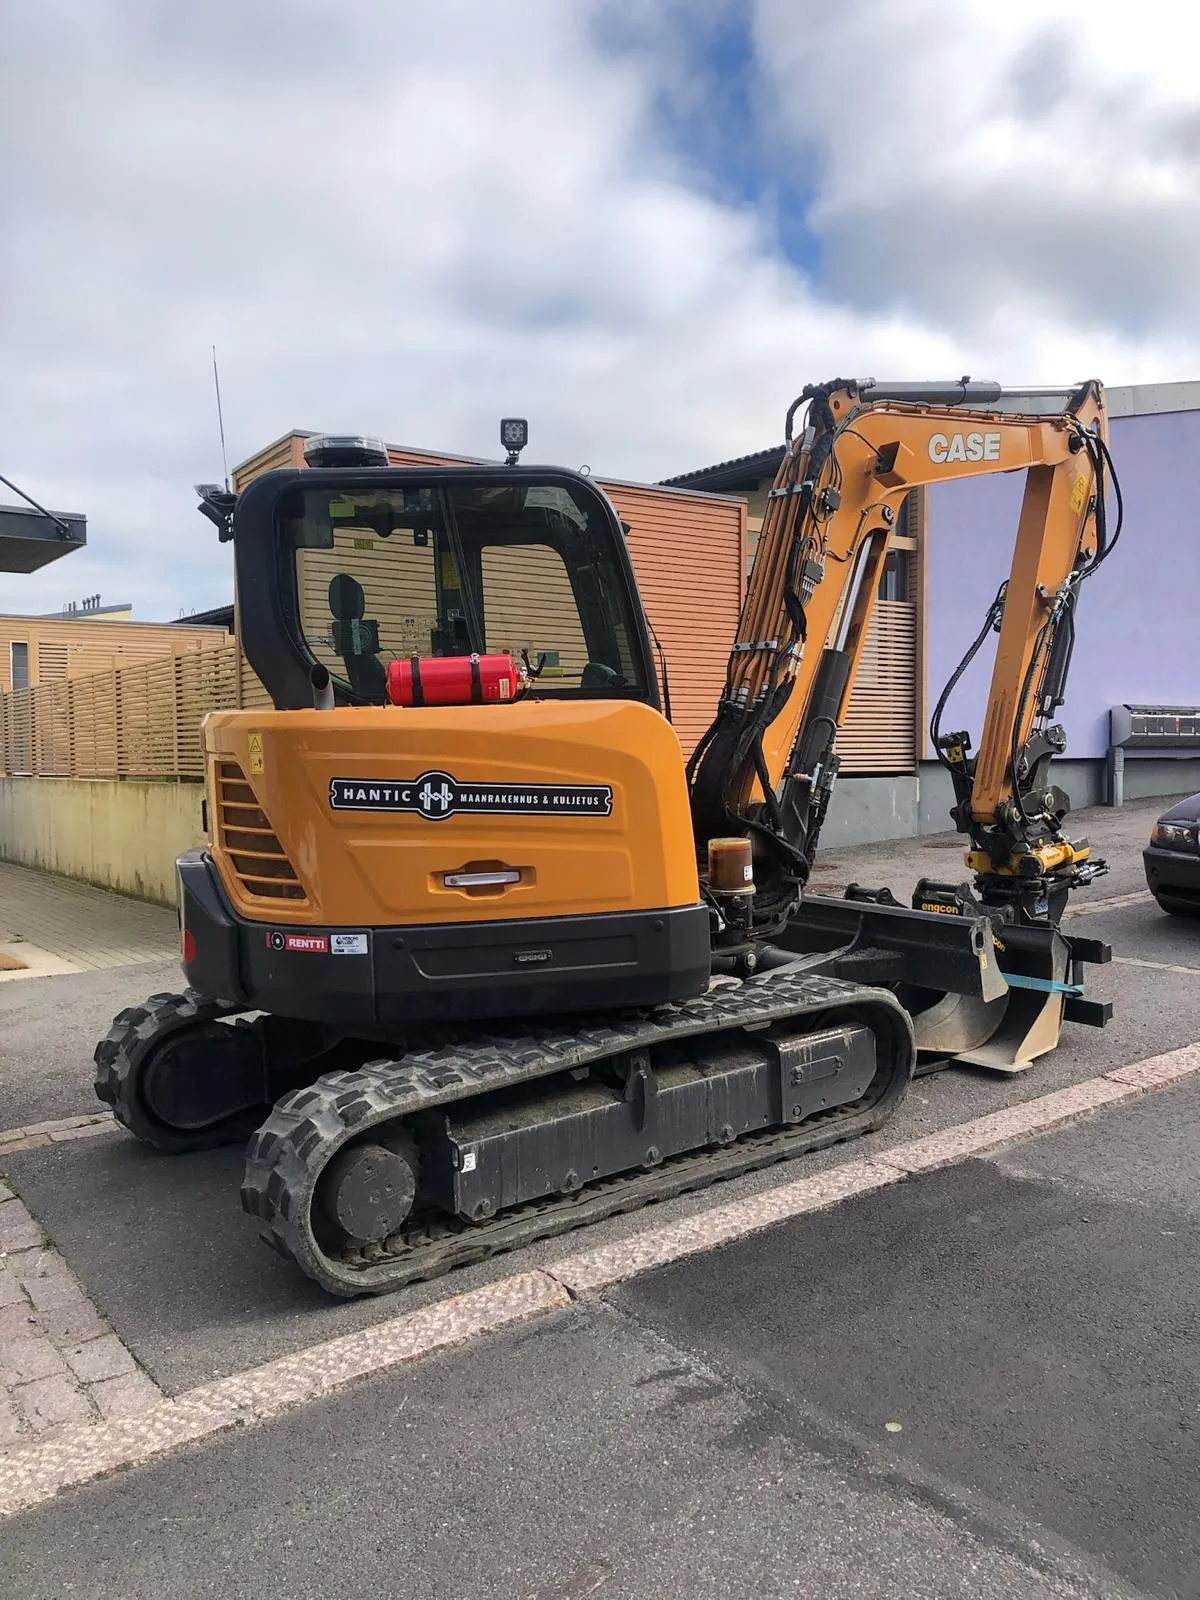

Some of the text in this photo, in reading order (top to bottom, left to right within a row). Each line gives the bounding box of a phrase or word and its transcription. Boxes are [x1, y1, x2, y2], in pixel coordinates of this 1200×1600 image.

[927, 432, 1001, 464] CASE
[343, 788, 411, 802] HANTIC
[460, 793, 538, 804] MAANRAKENNUS
[542, 796, 549, 804] &
[553, 796, 599, 805] KULJETUS
[921, 902, 959, 914] engcon
[288, 938, 325, 949] RENTTI
[992, 934, 1006, 953] con
